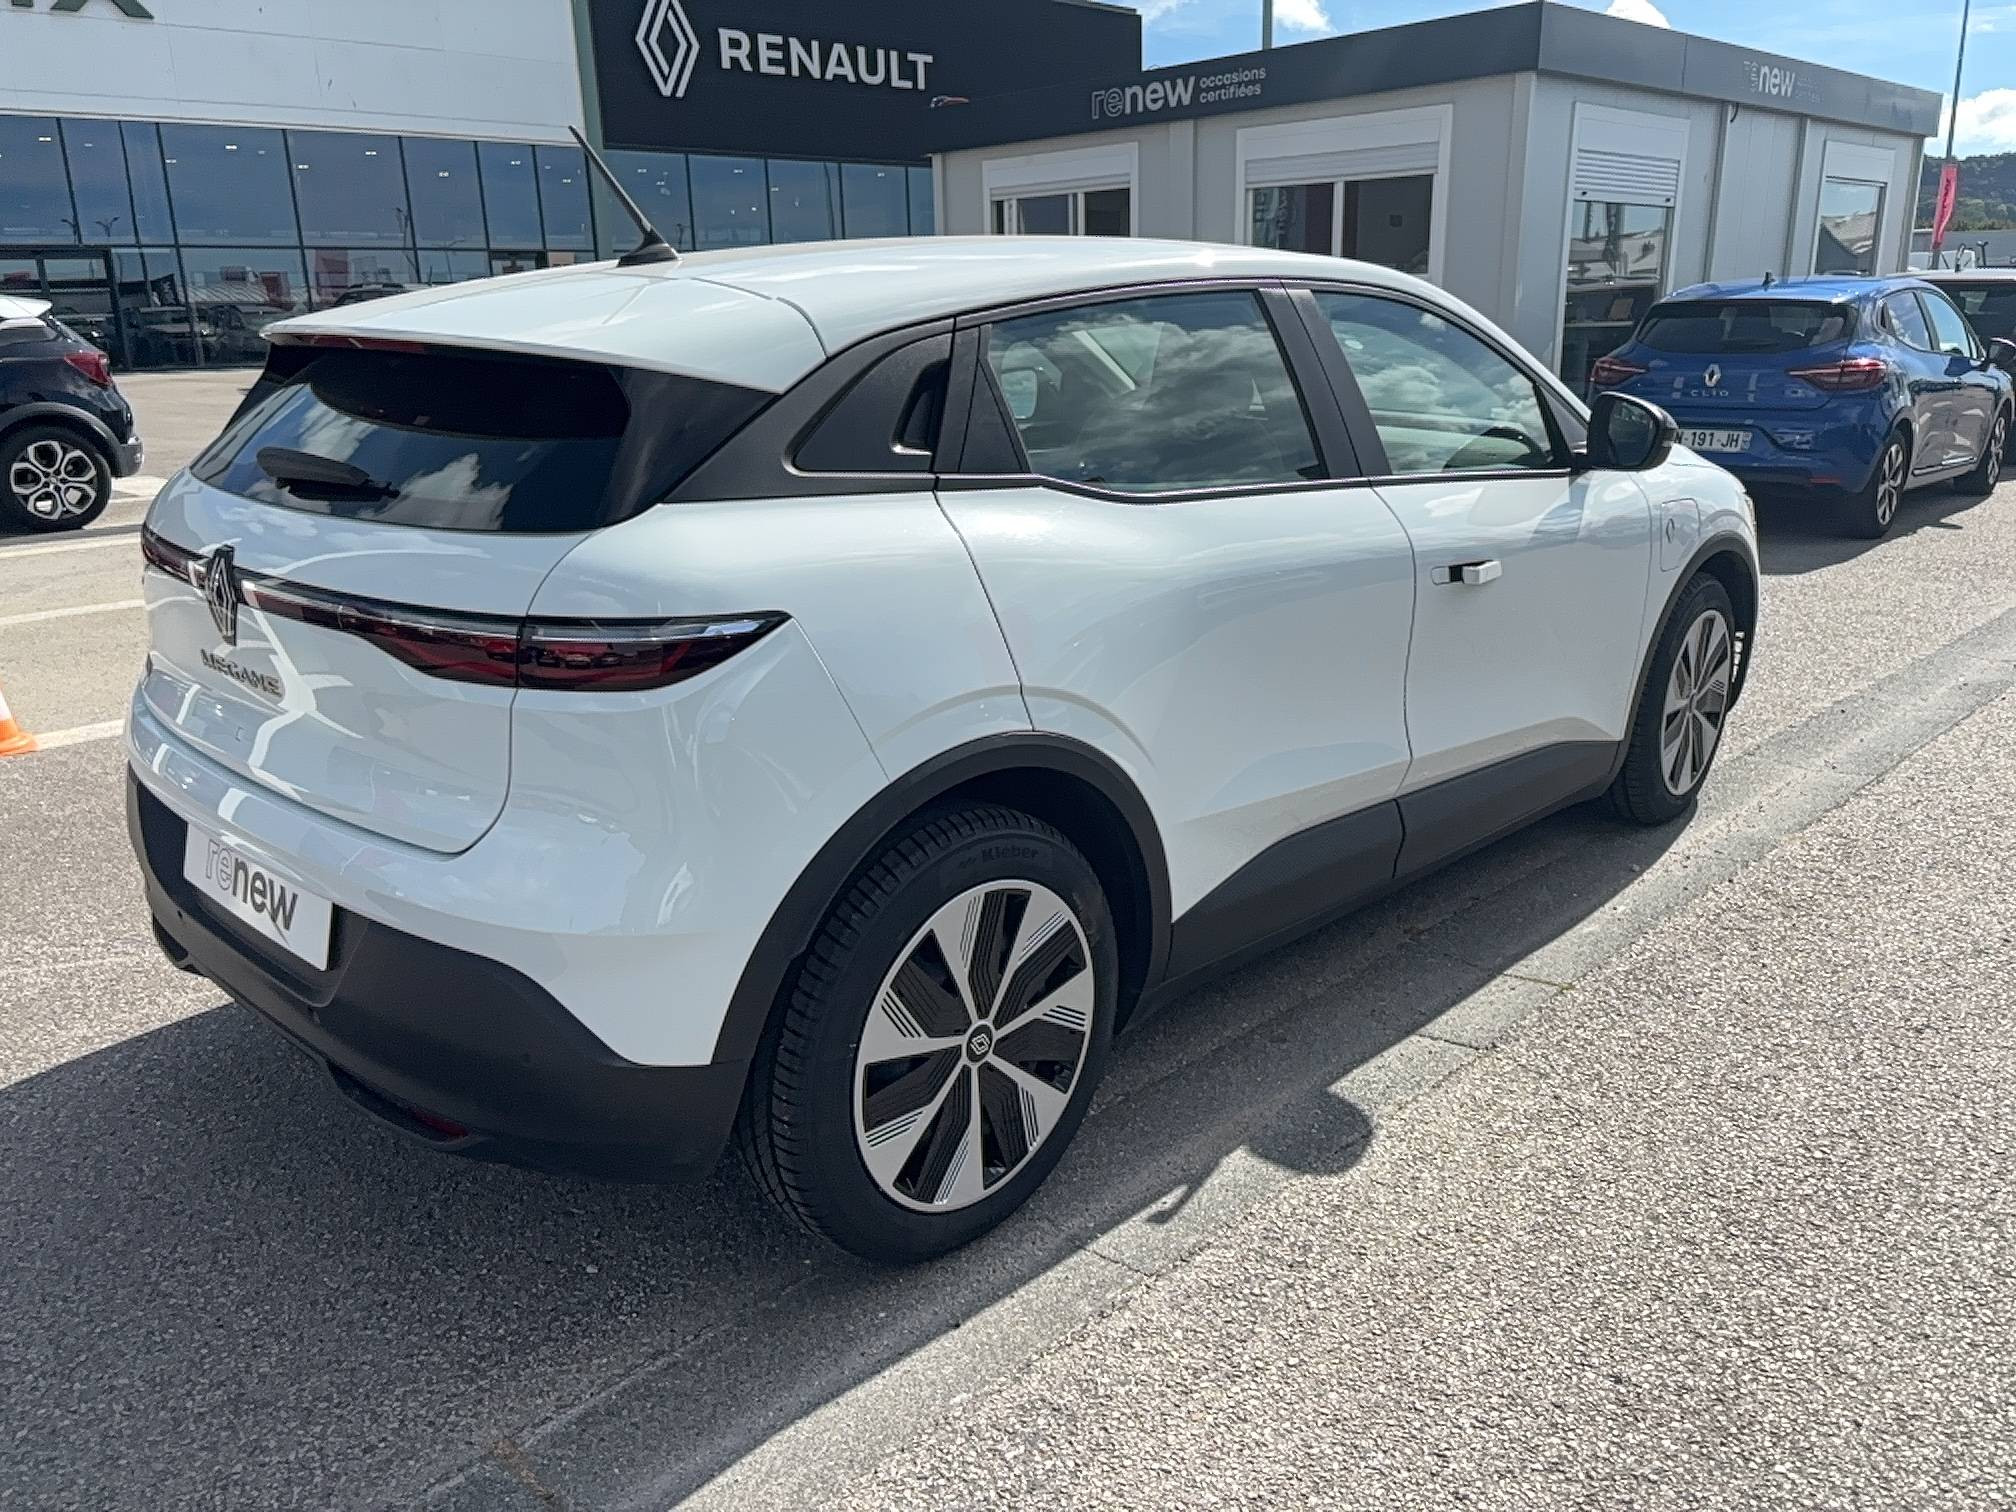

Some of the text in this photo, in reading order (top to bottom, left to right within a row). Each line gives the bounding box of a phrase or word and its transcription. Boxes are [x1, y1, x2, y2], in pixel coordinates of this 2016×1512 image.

[718, 27, 934, 91] RENAULT
[1200, 67, 1266, 88] occasions
[1091, 75, 1196, 119] renew
[1200, 83, 1262, 103] certifiées
[1690, 389, 1729, 397] CLIO
[200, 648, 282, 698] MEGANE
[205, 838, 299, 932] renew
